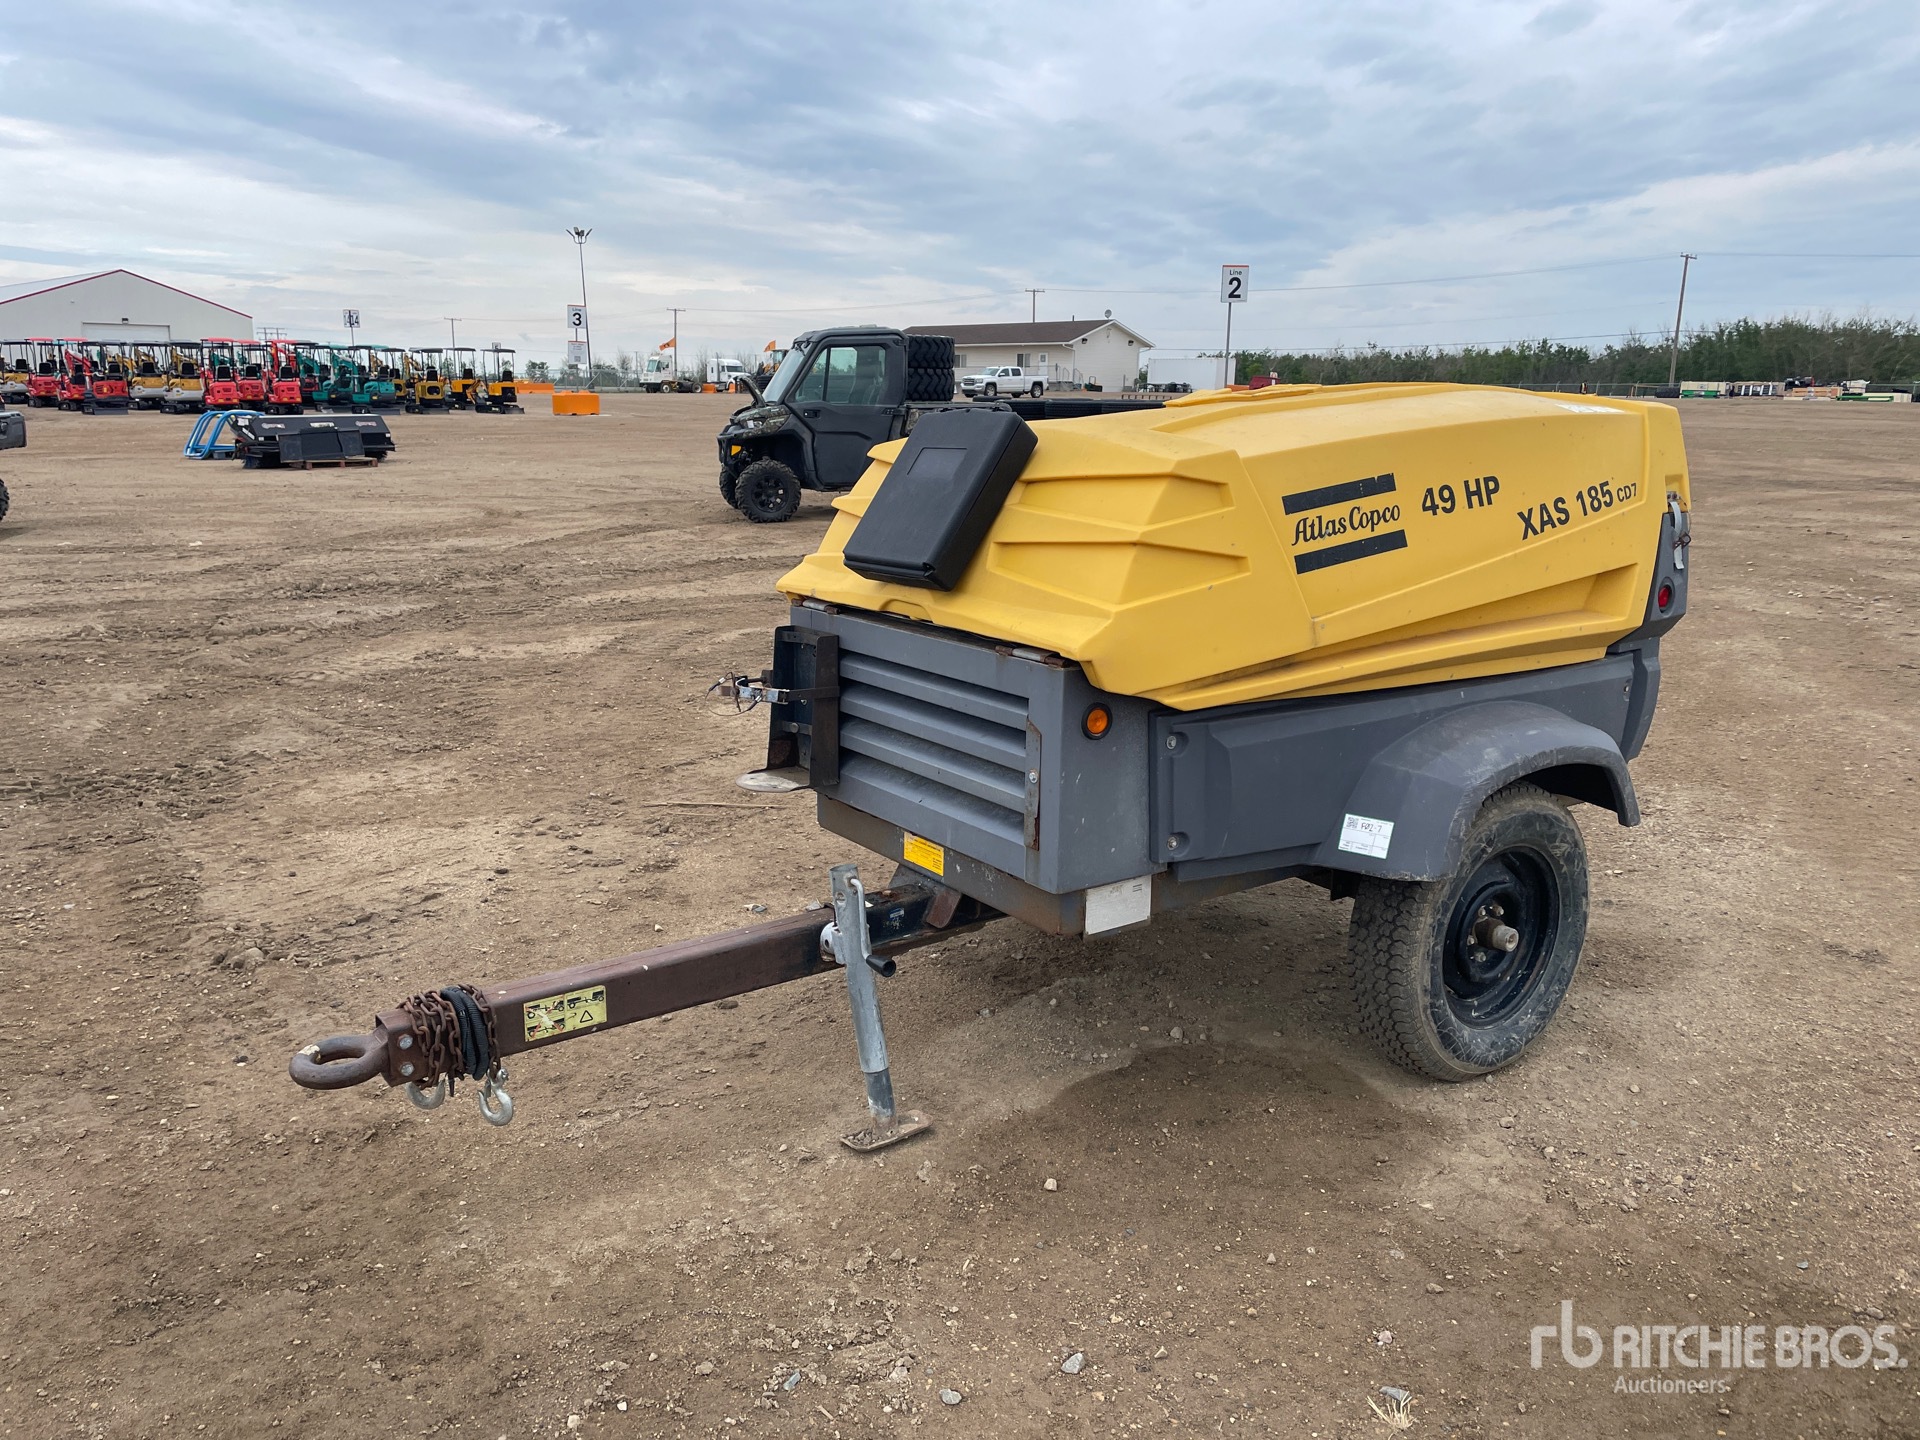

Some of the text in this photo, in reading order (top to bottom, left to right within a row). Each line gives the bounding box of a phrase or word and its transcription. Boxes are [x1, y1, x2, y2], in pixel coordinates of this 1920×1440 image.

[1228, 276, 1242, 298] 2
[572, 312, 582, 326] 3
[1421, 475, 1501, 516] 49 HP
[1517, 480, 1638, 540] XAS 185 CD7
[1291, 504, 1401, 546] Atlas Copco
